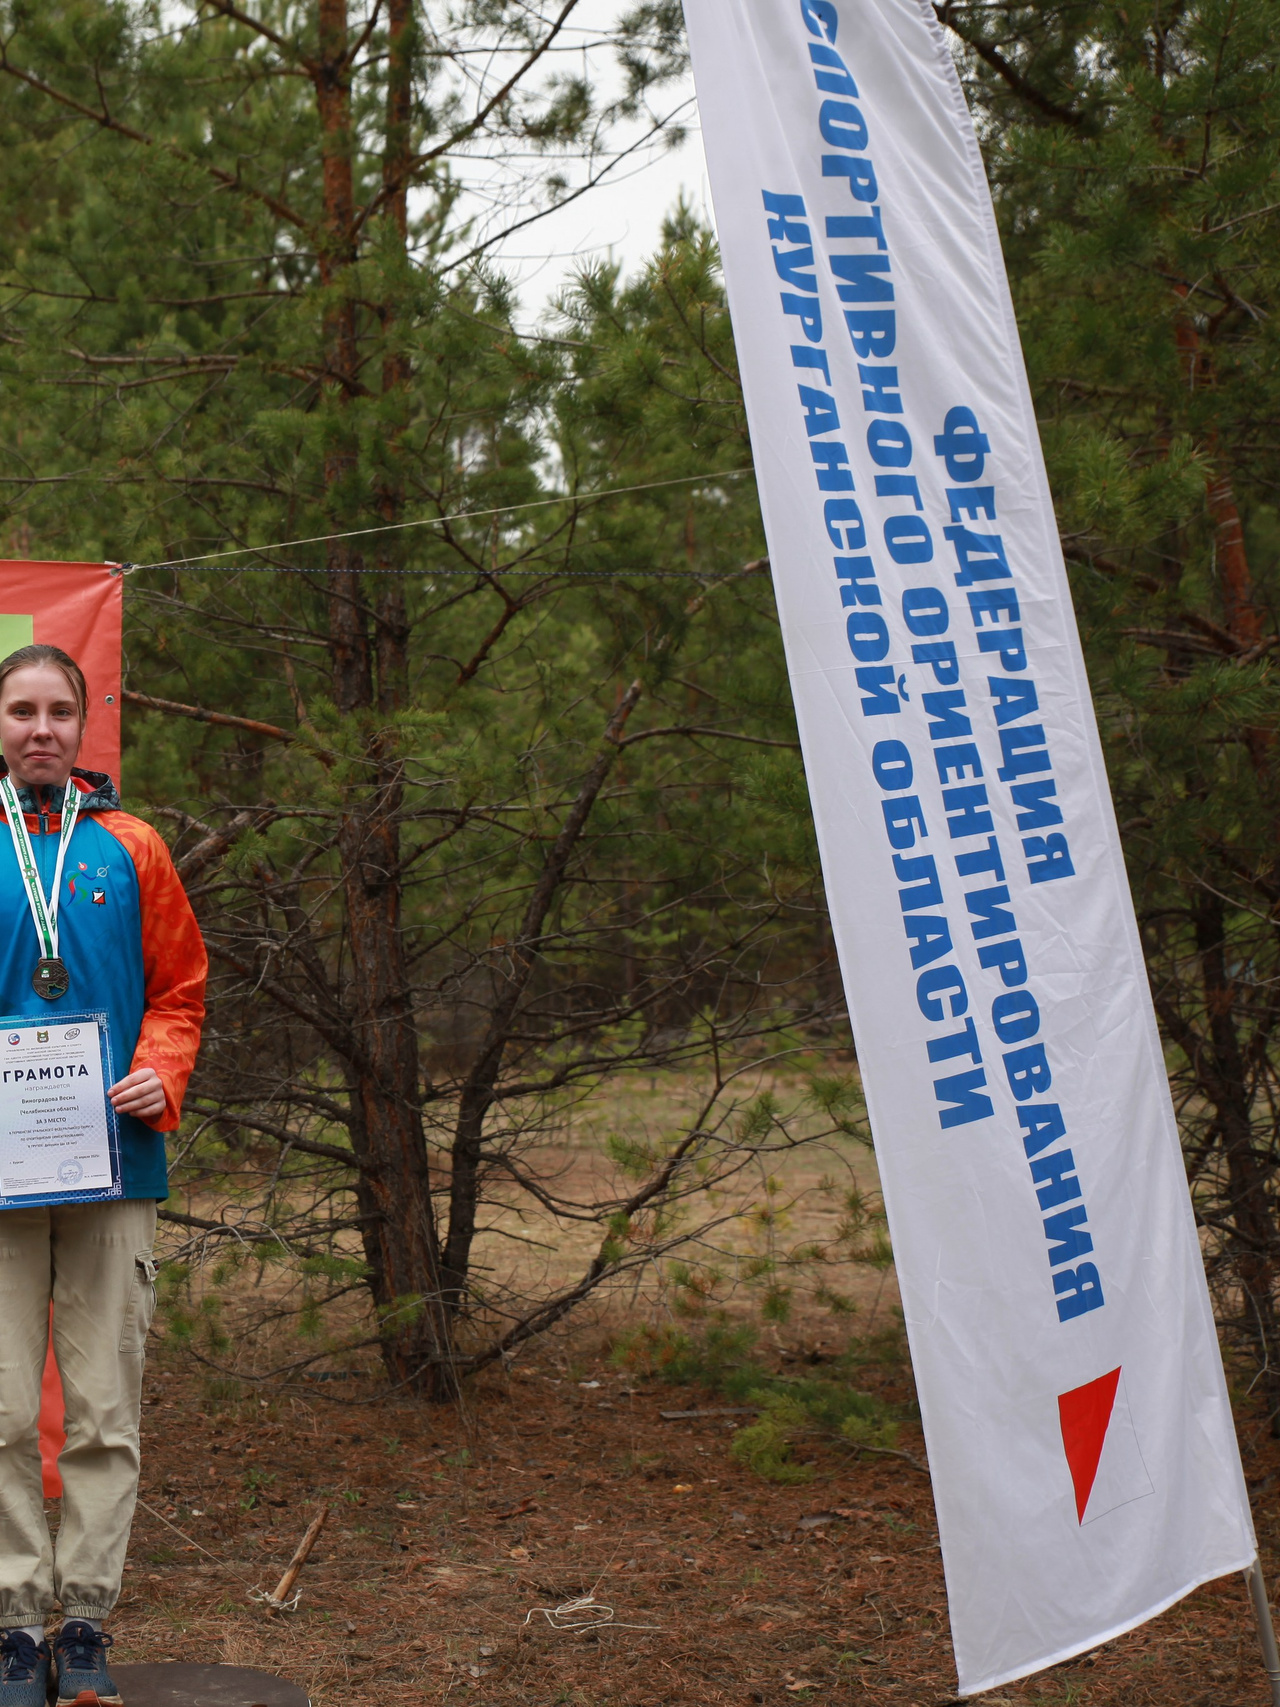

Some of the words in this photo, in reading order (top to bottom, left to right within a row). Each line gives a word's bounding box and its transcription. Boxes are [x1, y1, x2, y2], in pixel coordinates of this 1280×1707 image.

[934, 406, 1076, 884] ФЕДЕРАЦИЯ
[762, 190, 911, 717] КУРГАНСКОЙ
[872, 739, 995, 1130] ОБЛАСТИ
[801, 0, 934, 565] СПОРТИВНОГО
[902, 587, 1105, 1323] ОРИЕНТИРОВАНИЯ
[3, 1064, 89, 1083] ГРАМОТА
[24, 1083, 71, 1092] награждается
[20, 1107, 56, 1115] (Челябинская
[56, 1105, 79, 1113] область)
[21, 1096, 58, 1105] Виноградова
